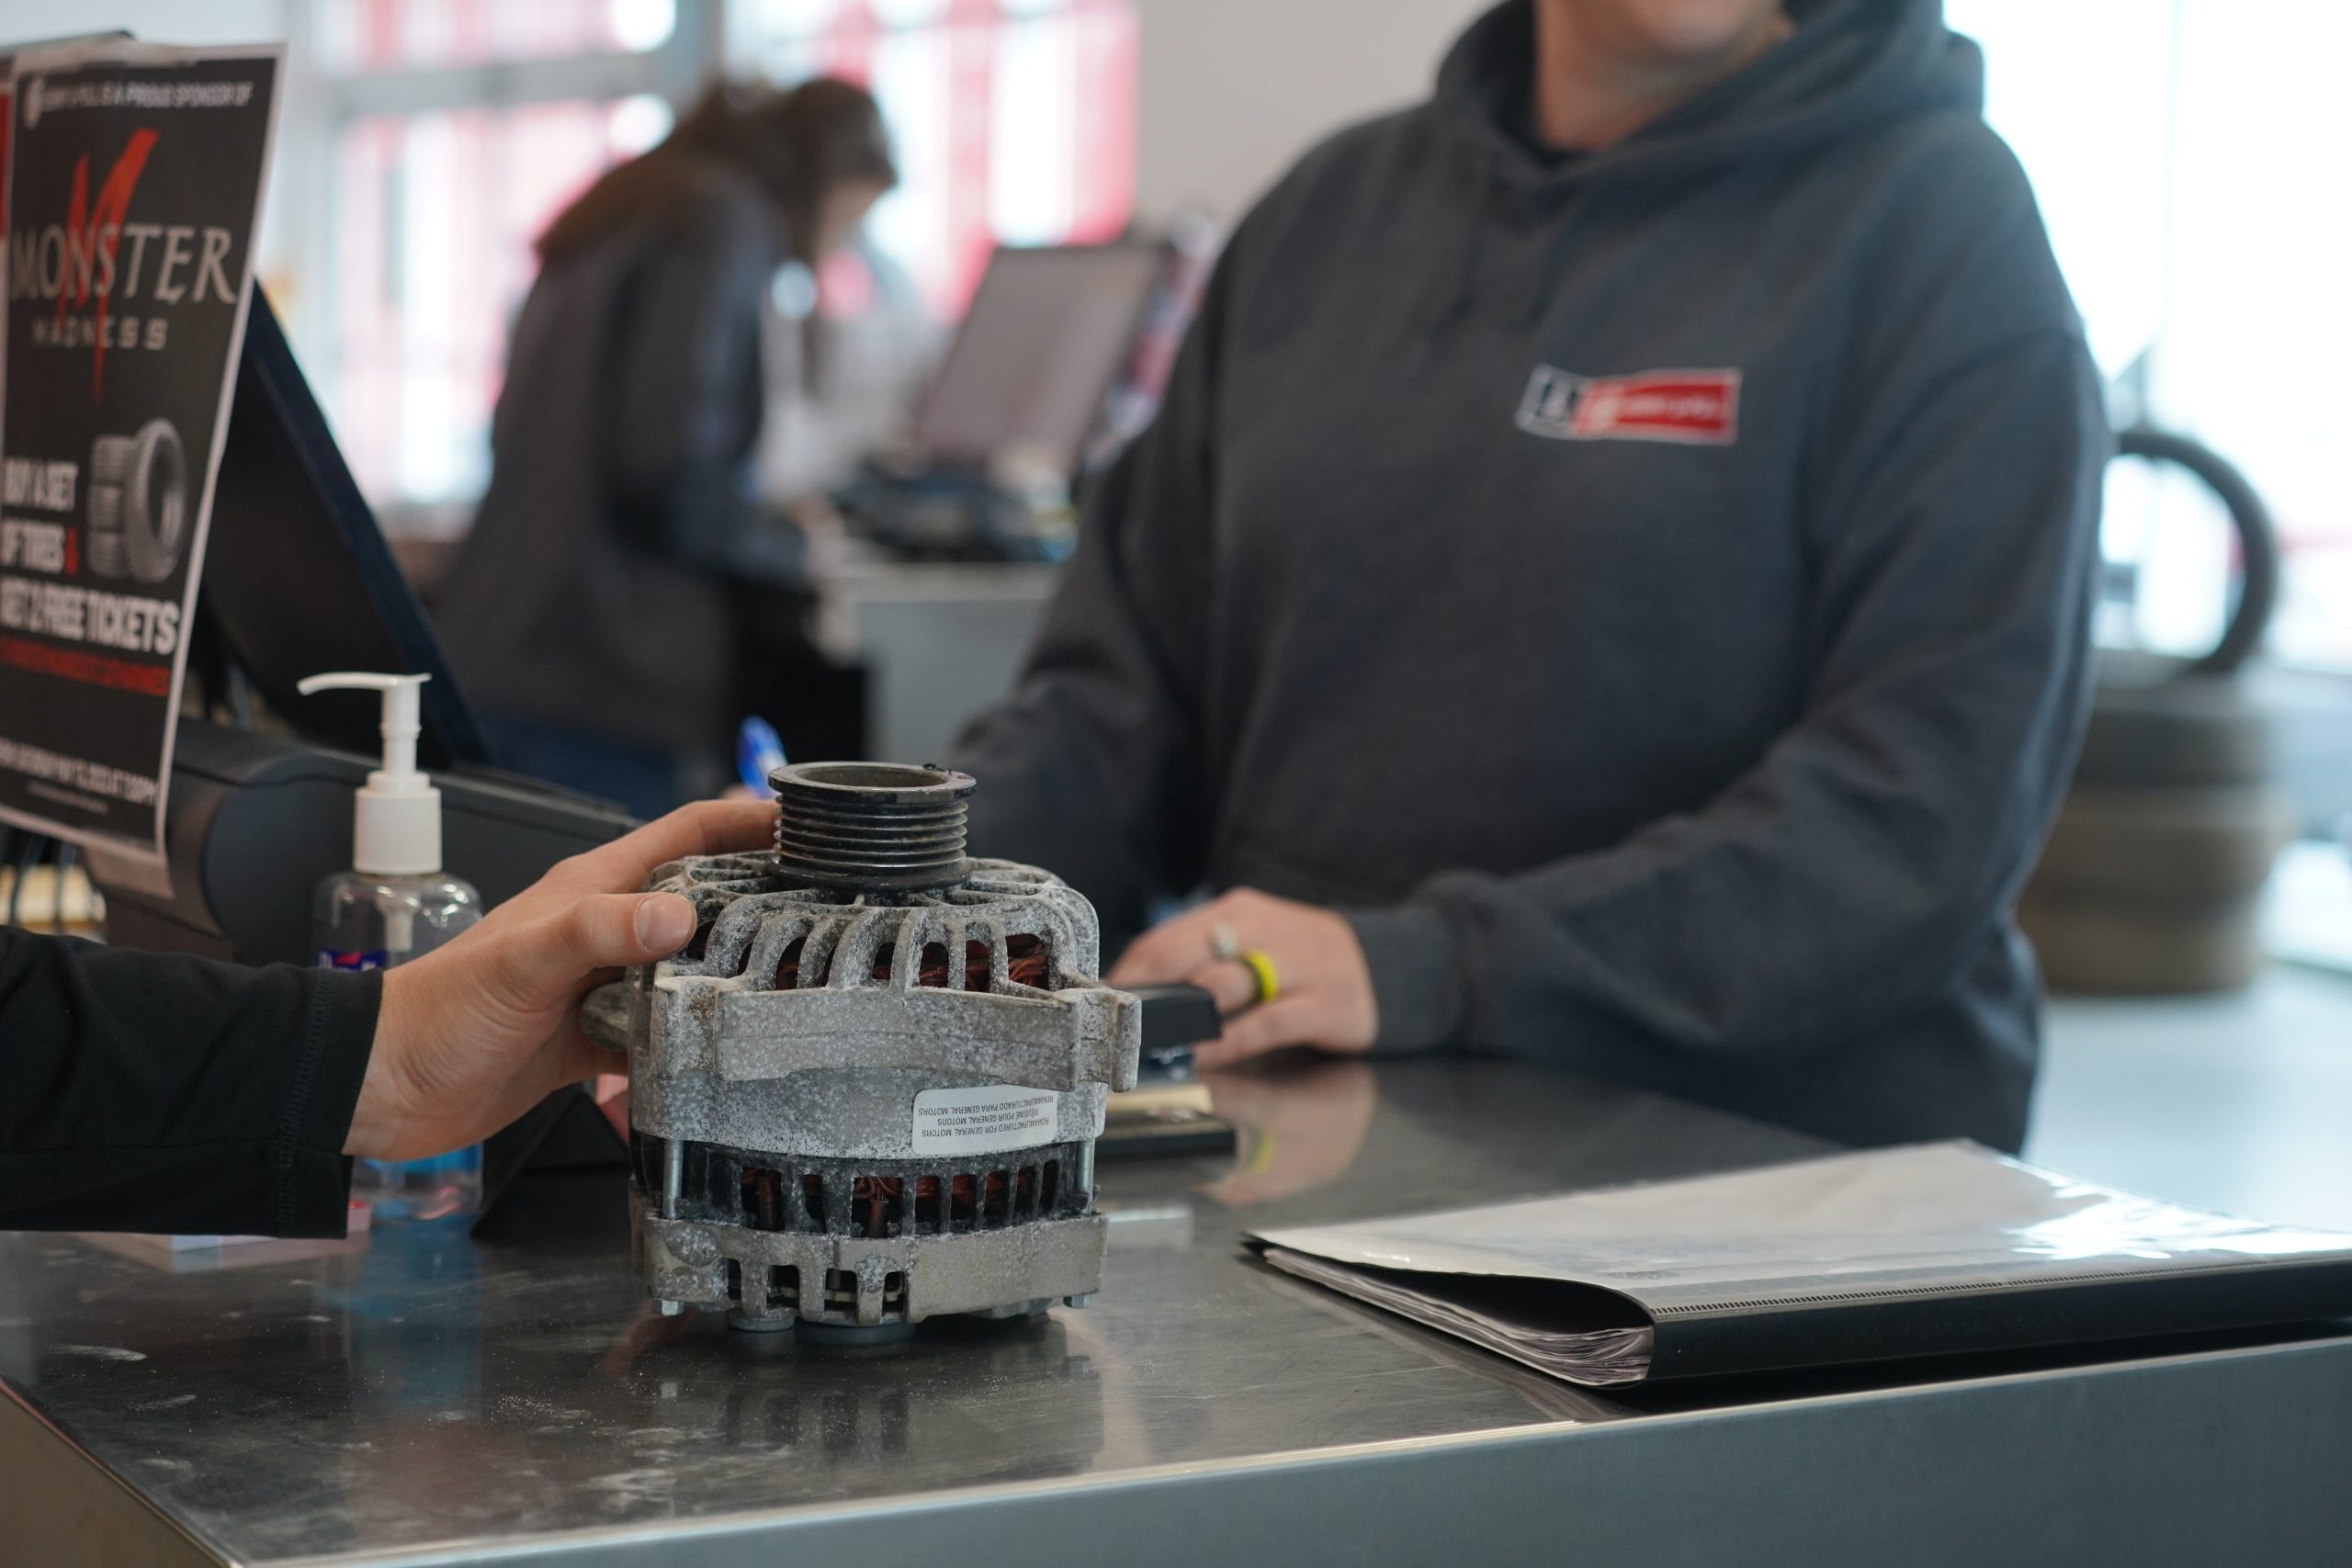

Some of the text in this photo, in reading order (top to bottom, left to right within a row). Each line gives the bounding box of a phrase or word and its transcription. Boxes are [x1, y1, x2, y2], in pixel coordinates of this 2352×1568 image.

[8, 223, 237, 304] MONSTER
[33, 314, 168, 350] MADNESS
[86, 591, 180, 655] TICKETS
[919, 1095, 1054, 1116] REMANUFACTURADO PARA GENERAL MOTORS
[969, 1116, 997, 1124] GENERAL
[999, 1112, 1014, 1121] POUR
[999, 1118, 1048, 1132] REMANUFACTURED
[954, 1127, 984, 1135] GENERAL
